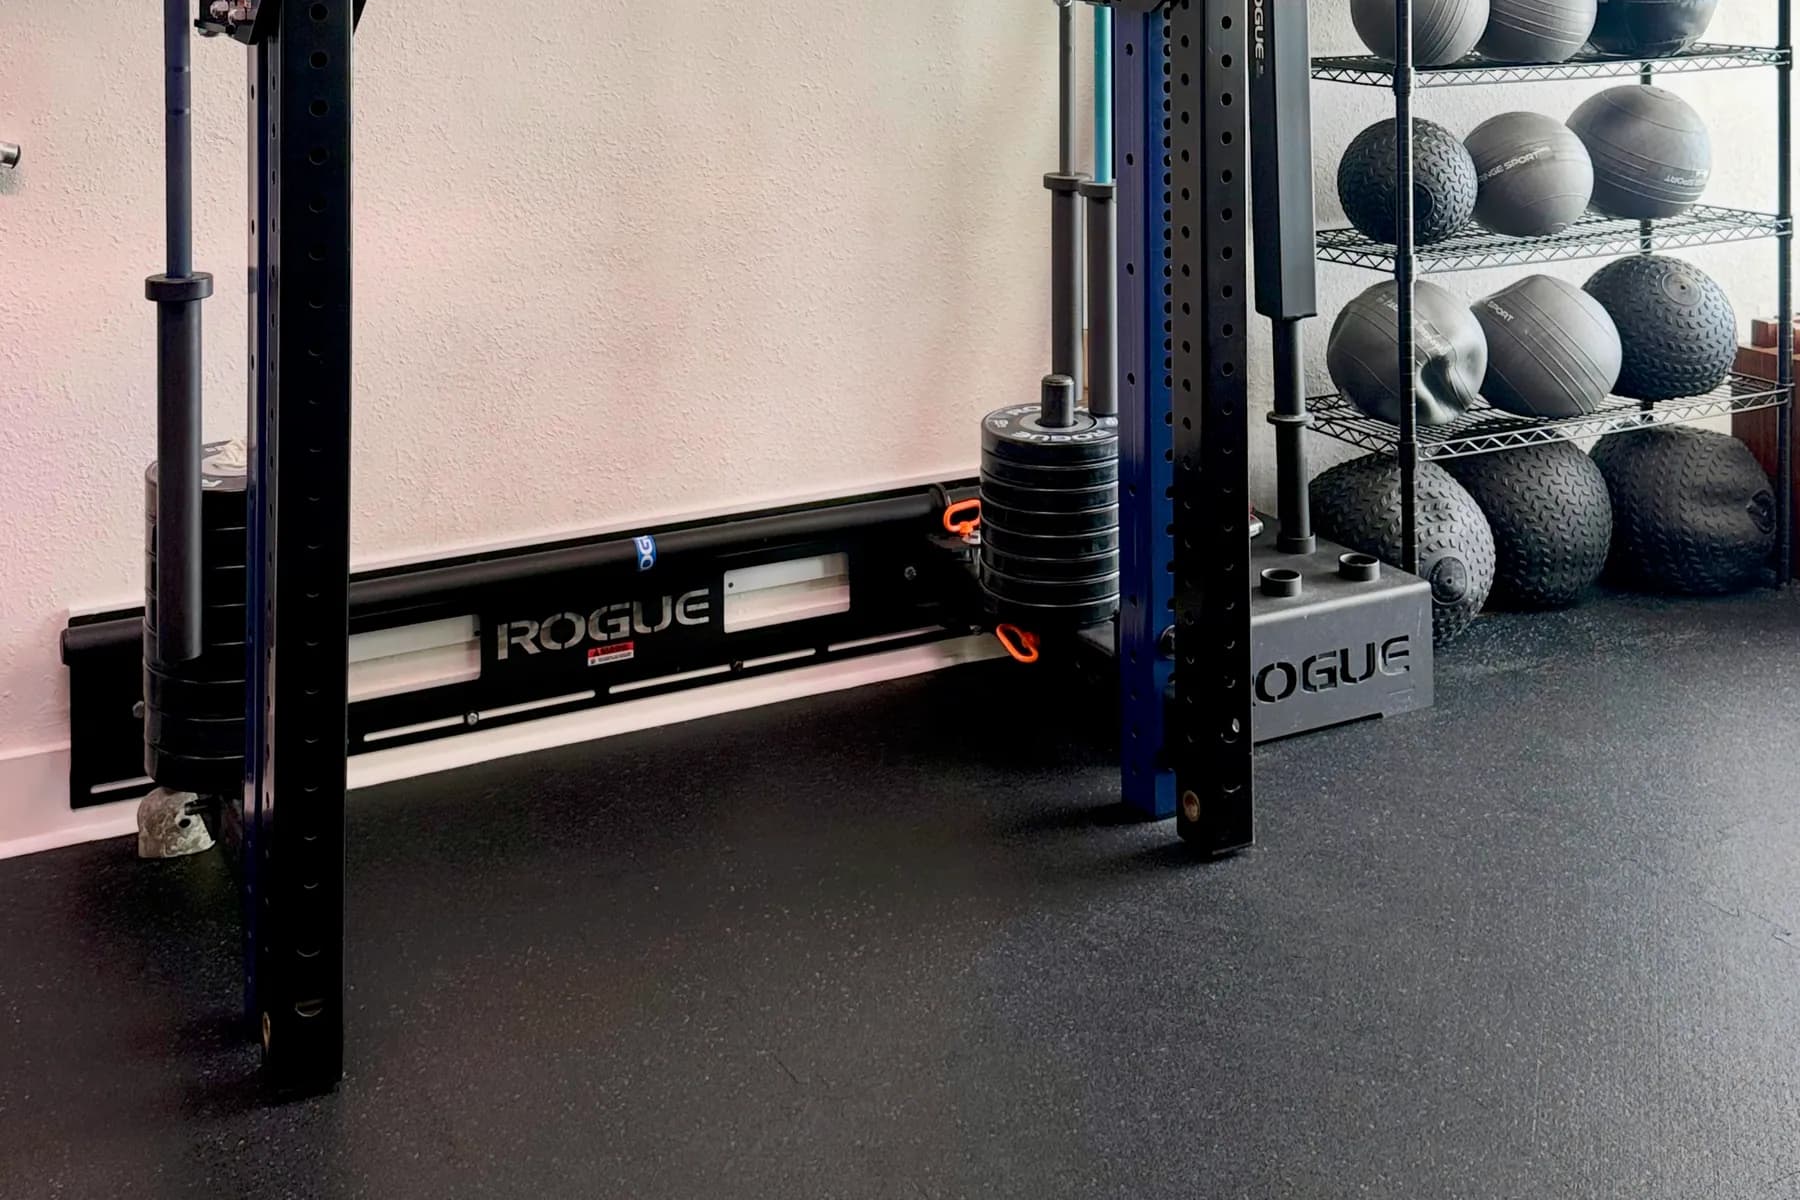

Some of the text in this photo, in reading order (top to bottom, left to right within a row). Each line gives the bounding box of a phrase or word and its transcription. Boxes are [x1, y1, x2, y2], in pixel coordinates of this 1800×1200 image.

[1504, 151, 1540, 171] SPORT
[1487, 301, 1514, 322] SPORT
[497, 588, 709, 660] ROGUE
[1252, 634, 1410, 706] OGUE
